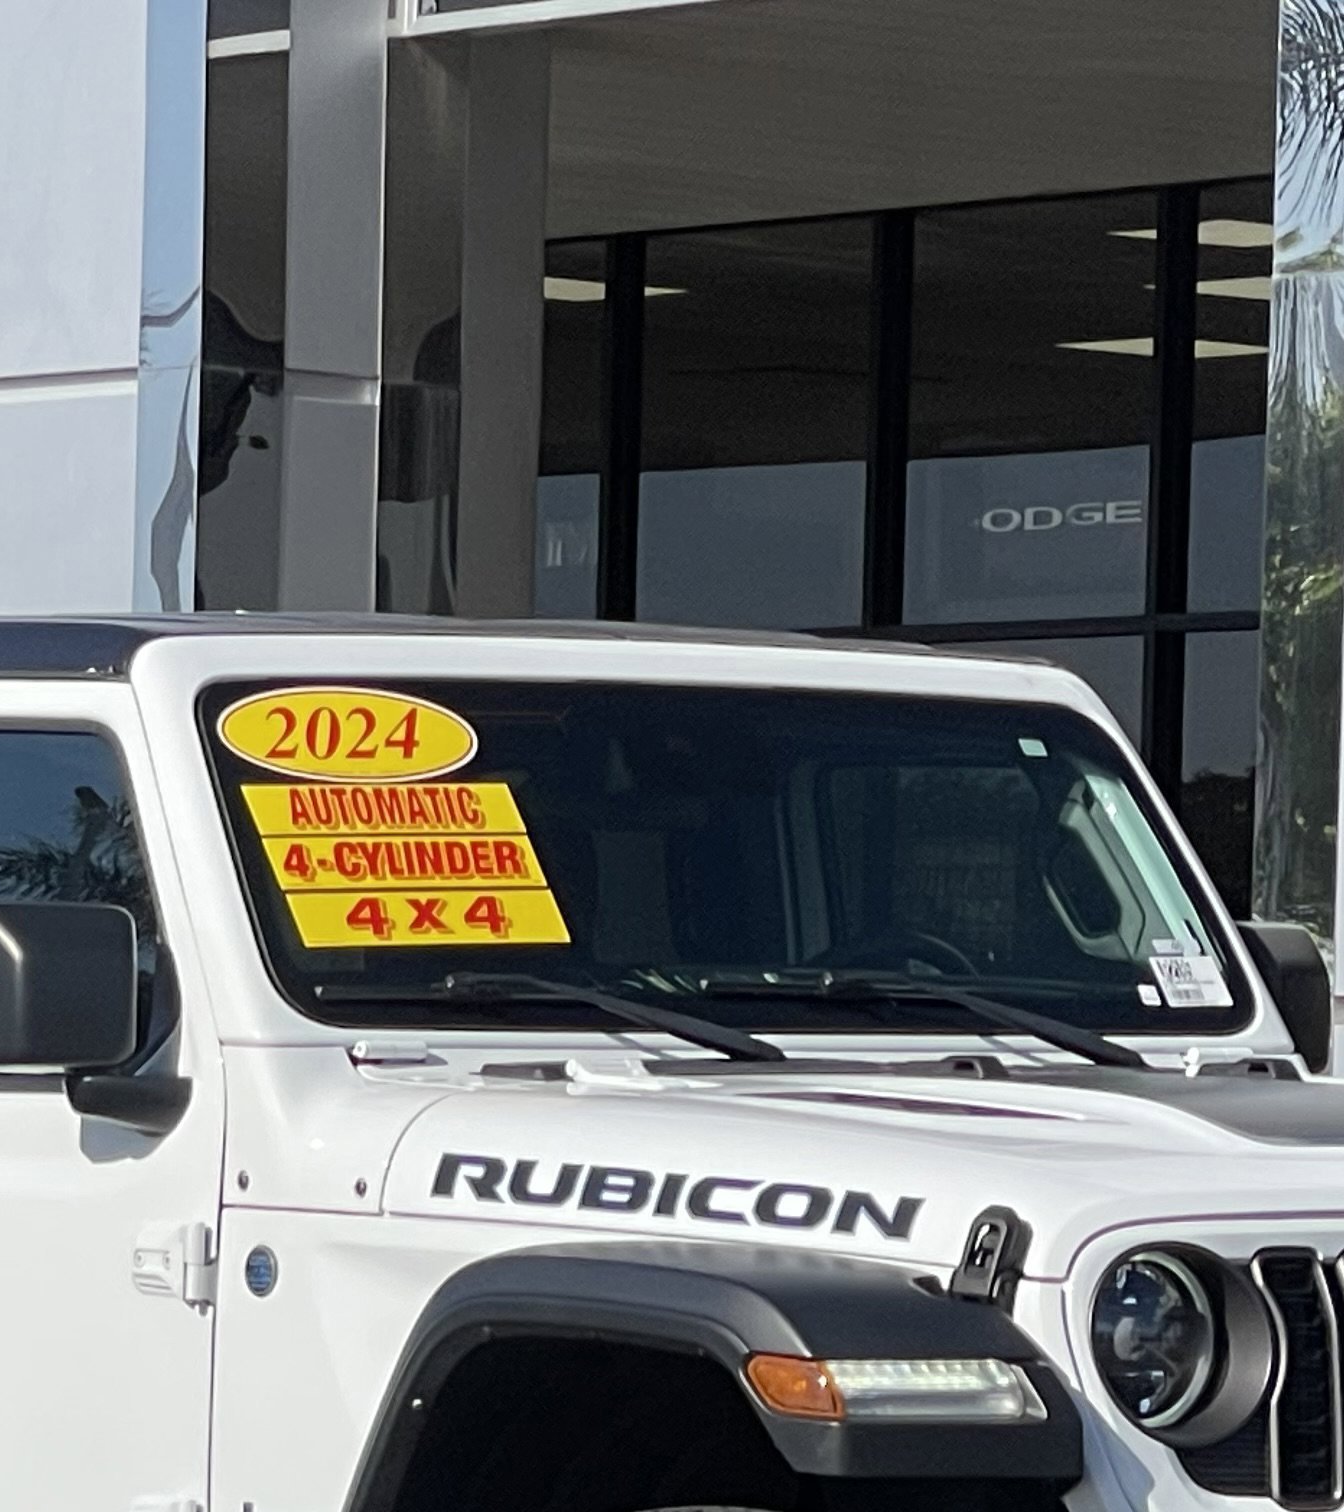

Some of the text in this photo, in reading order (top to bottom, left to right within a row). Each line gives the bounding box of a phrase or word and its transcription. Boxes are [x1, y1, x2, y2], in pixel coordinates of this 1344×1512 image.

[264, 706, 420, 761] 2024
[290, 785, 486, 829] AUTOMATIC
[283, 840, 526, 880] 4-CYLINDER
[430, 1152, 926, 1240] RUBICON
